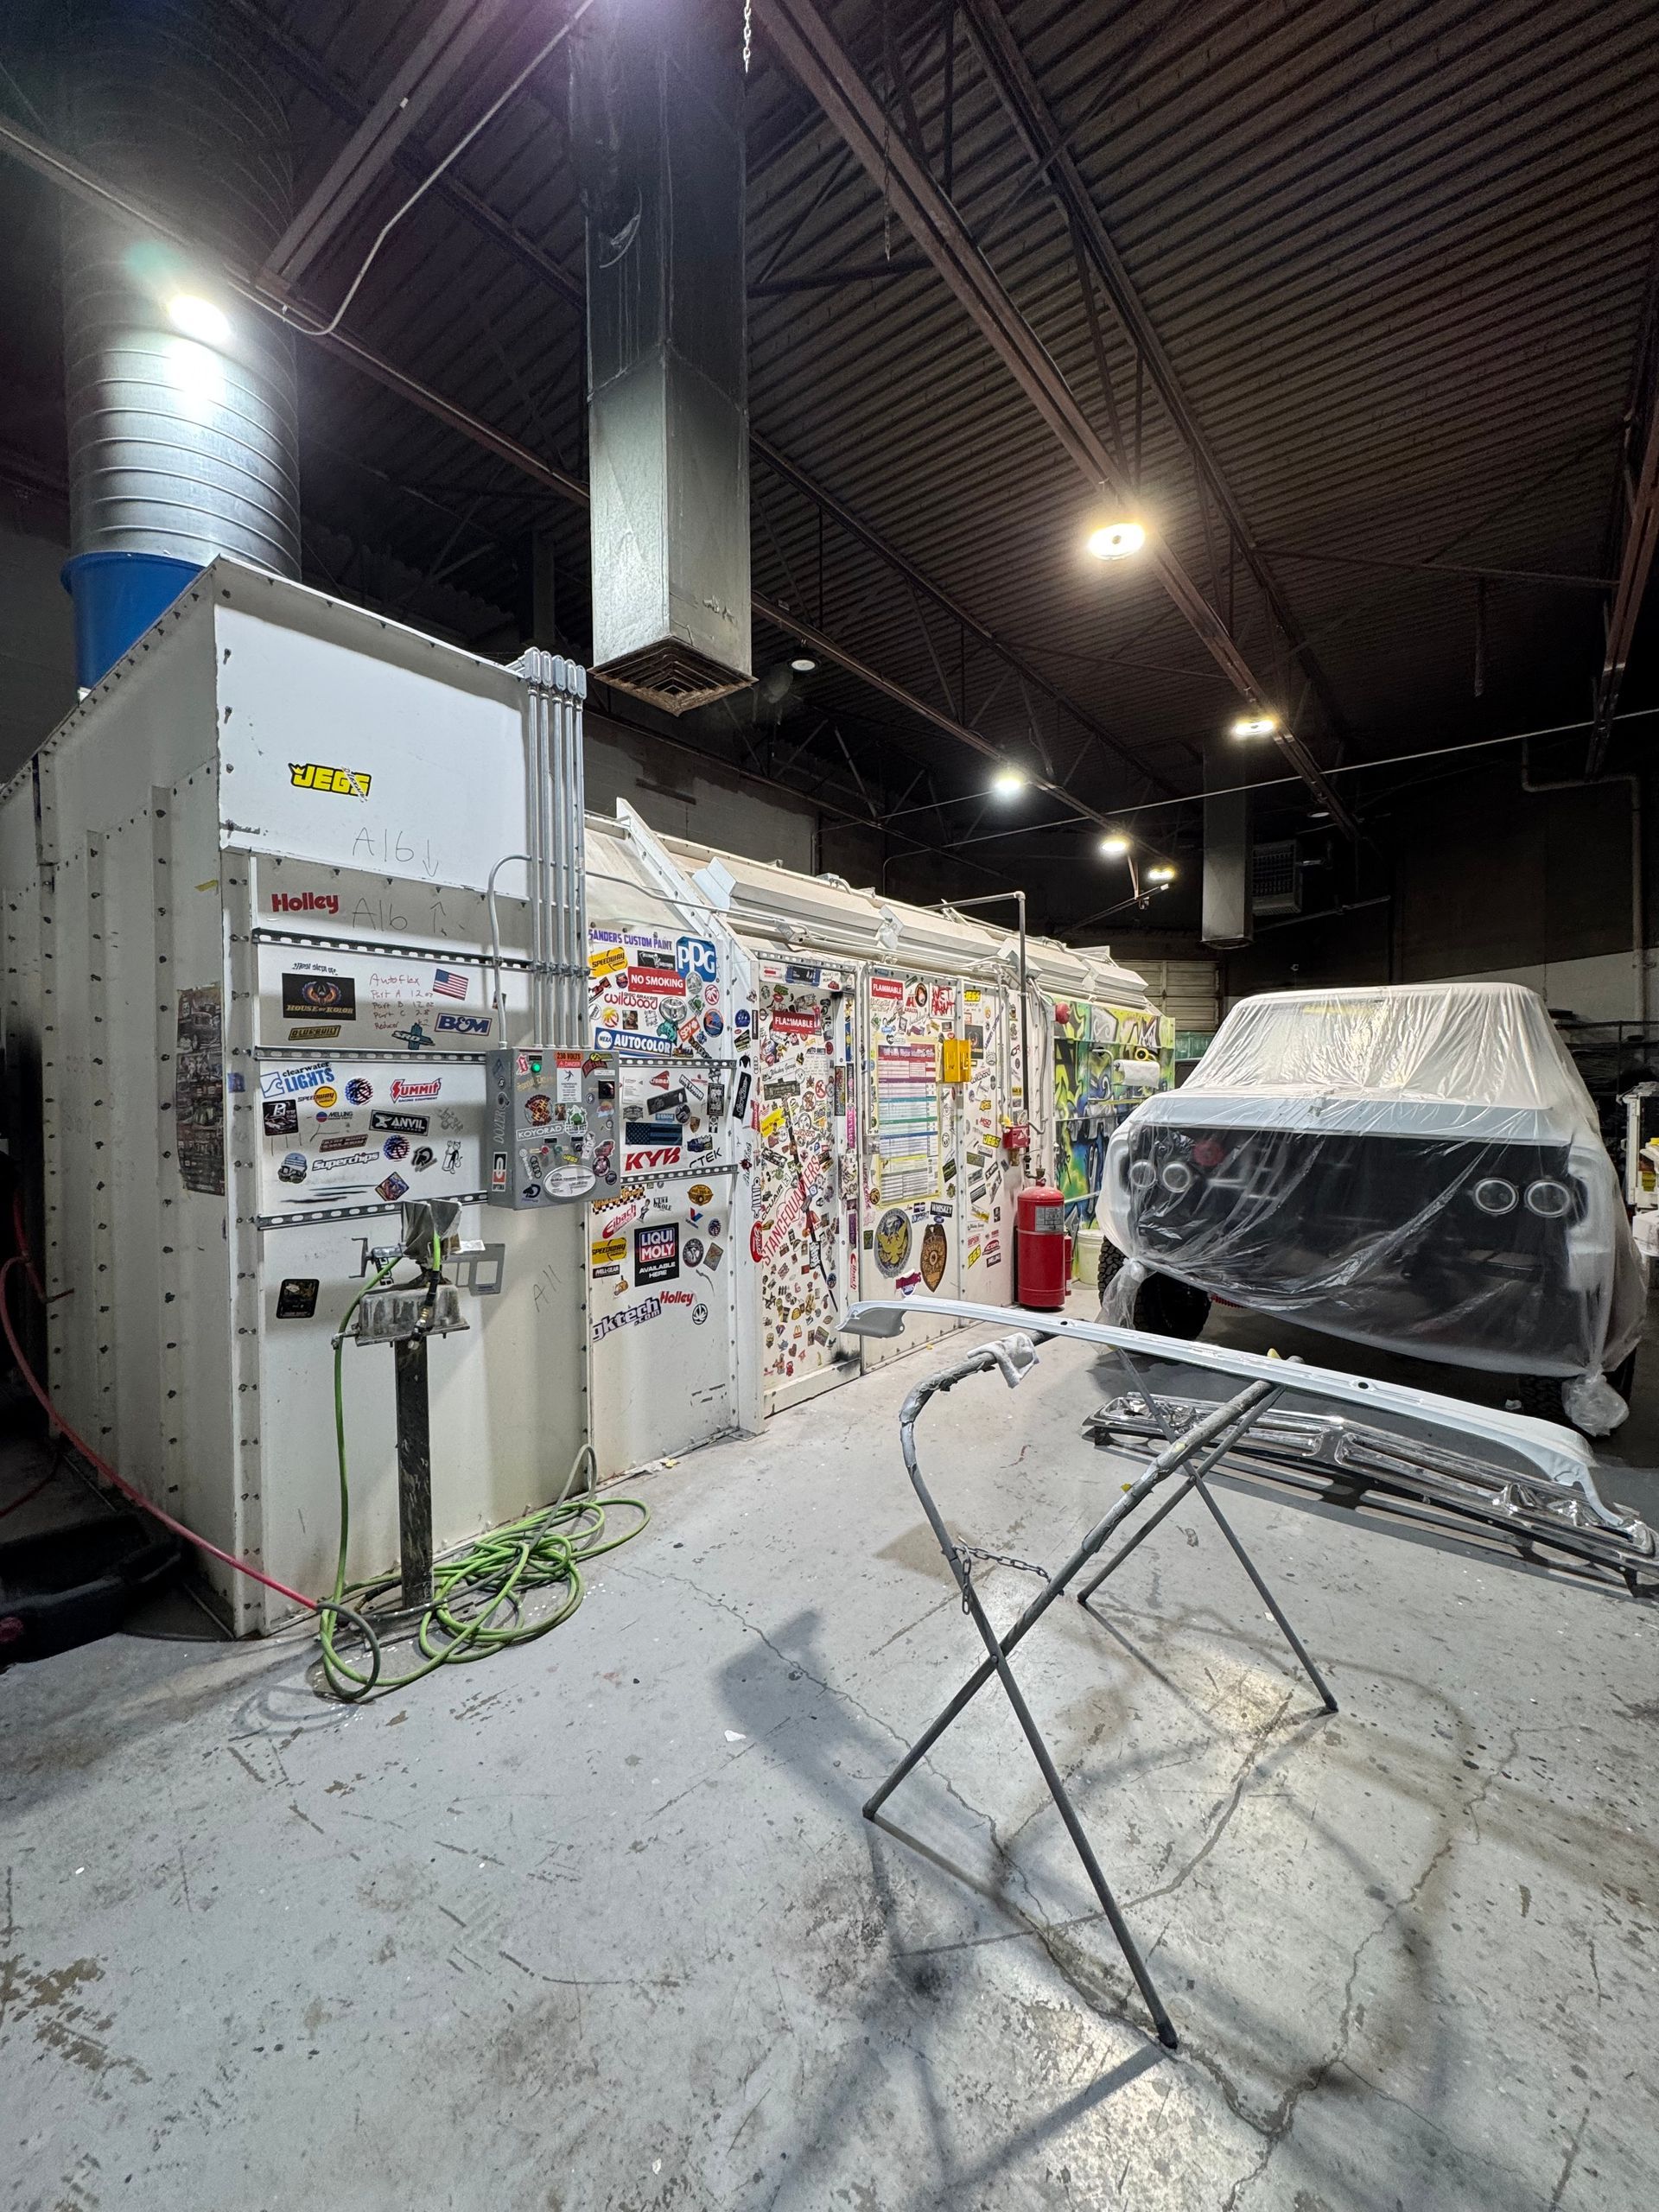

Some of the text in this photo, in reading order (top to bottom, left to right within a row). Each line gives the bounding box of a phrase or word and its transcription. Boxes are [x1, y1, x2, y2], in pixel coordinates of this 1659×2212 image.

[292, 764, 372, 797] JEGS
[271, 892, 340, 914] Holley
[588, 929, 672, 950] SANDERS CUSTOM PAINT
[591, 952, 626, 968] SPEEDWAY
[677, 940, 715, 974] PPG
[631, 974, 683, 988] NO SMOKING
[873, 983, 902, 994] FLAMMABLE
[604, 991, 658, 1010] wilwood
[437, 1014, 490, 1033] B&M
[613, 1033, 671, 1054] AUTOCOLOR
[282, 1062, 331, 1077] clearwater
[284, 1067, 335, 1093] LIGHTS
[297, 1092, 334, 1103] SPEEDWAY
[391, 1078, 440, 1103] SUMMIT
[391, 1116, 426, 1130] ANVIL
[518, 1125, 563, 1139] KOYORAD
[983, 1134, 1001, 1148] JEGS
[312, 1152, 379, 1171] Superchips
[625, 1147, 681, 1172] KYB
[931, 1205, 952, 1213] WHISKEY
[602, 1202, 637, 1239] Eibach
[641, 1230, 674, 1245] LIQUI
[592, 1243, 626, 1255] SPEEDWAY
[641, 1243, 675, 1261] MOLY
[639, 1262, 677, 1274] AVAILABLE
[649, 1270, 667, 1279] HERE
[660, 1291, 694, 1306] Holley
[592, 1297, 660, 1341] gktech
[633, 1310, 661, 1325] .com
